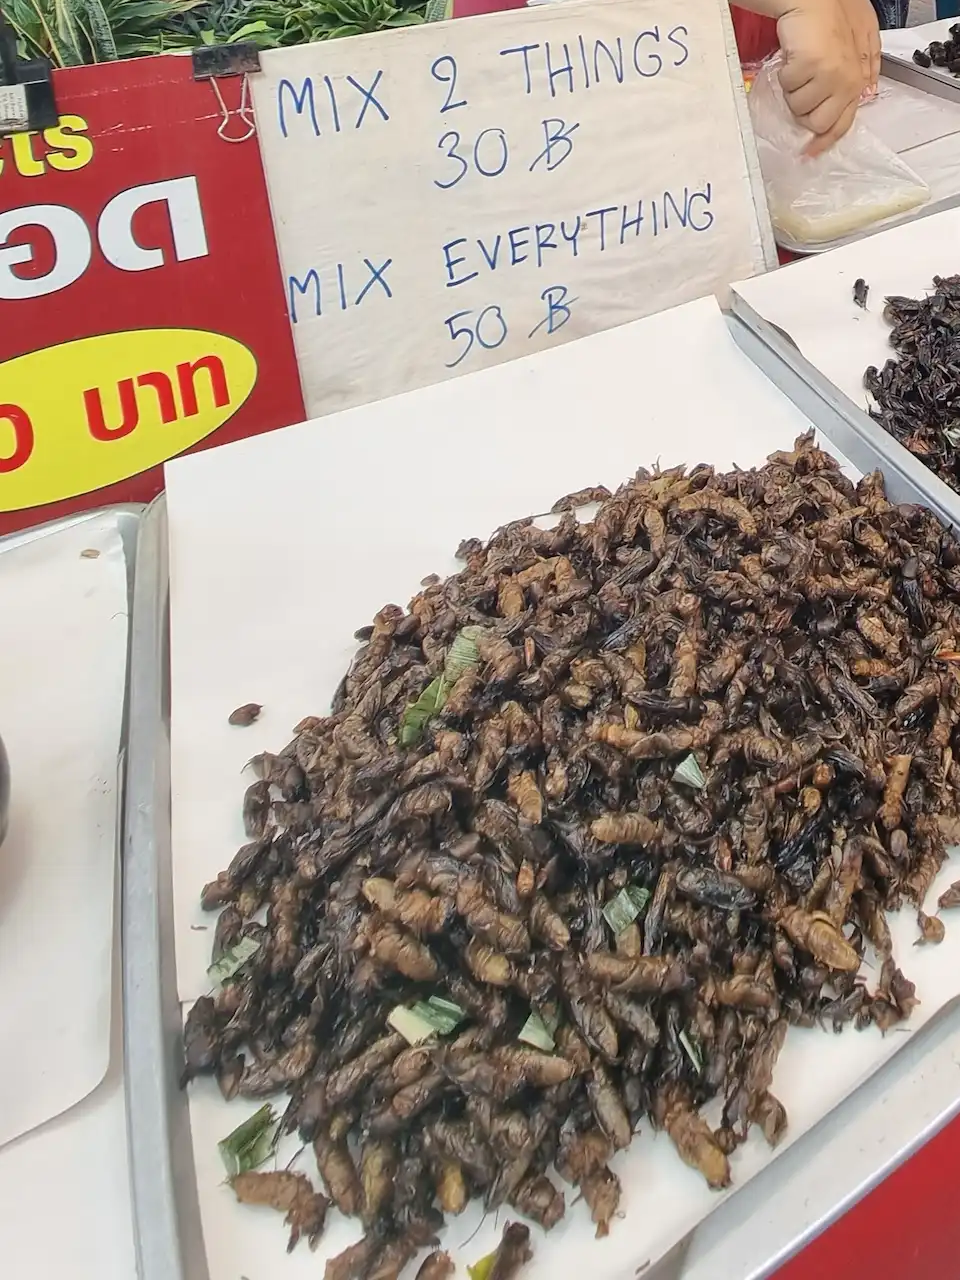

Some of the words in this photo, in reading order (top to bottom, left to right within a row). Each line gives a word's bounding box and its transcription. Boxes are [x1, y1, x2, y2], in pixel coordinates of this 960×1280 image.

[277, 69, 390, 139] MIX
[430, 55, 469, 115] 2
[500, 24, 691, 100] THINGS
[0, 113, 94, 178] ts
[432, 126, 509, 190] 30
[288, 256, 394, 324] MIX
[442, 182, 715, 290] EVERYTHING
[444, 304, 509, 368] 50
[82, 353, 231, 443] บาท
